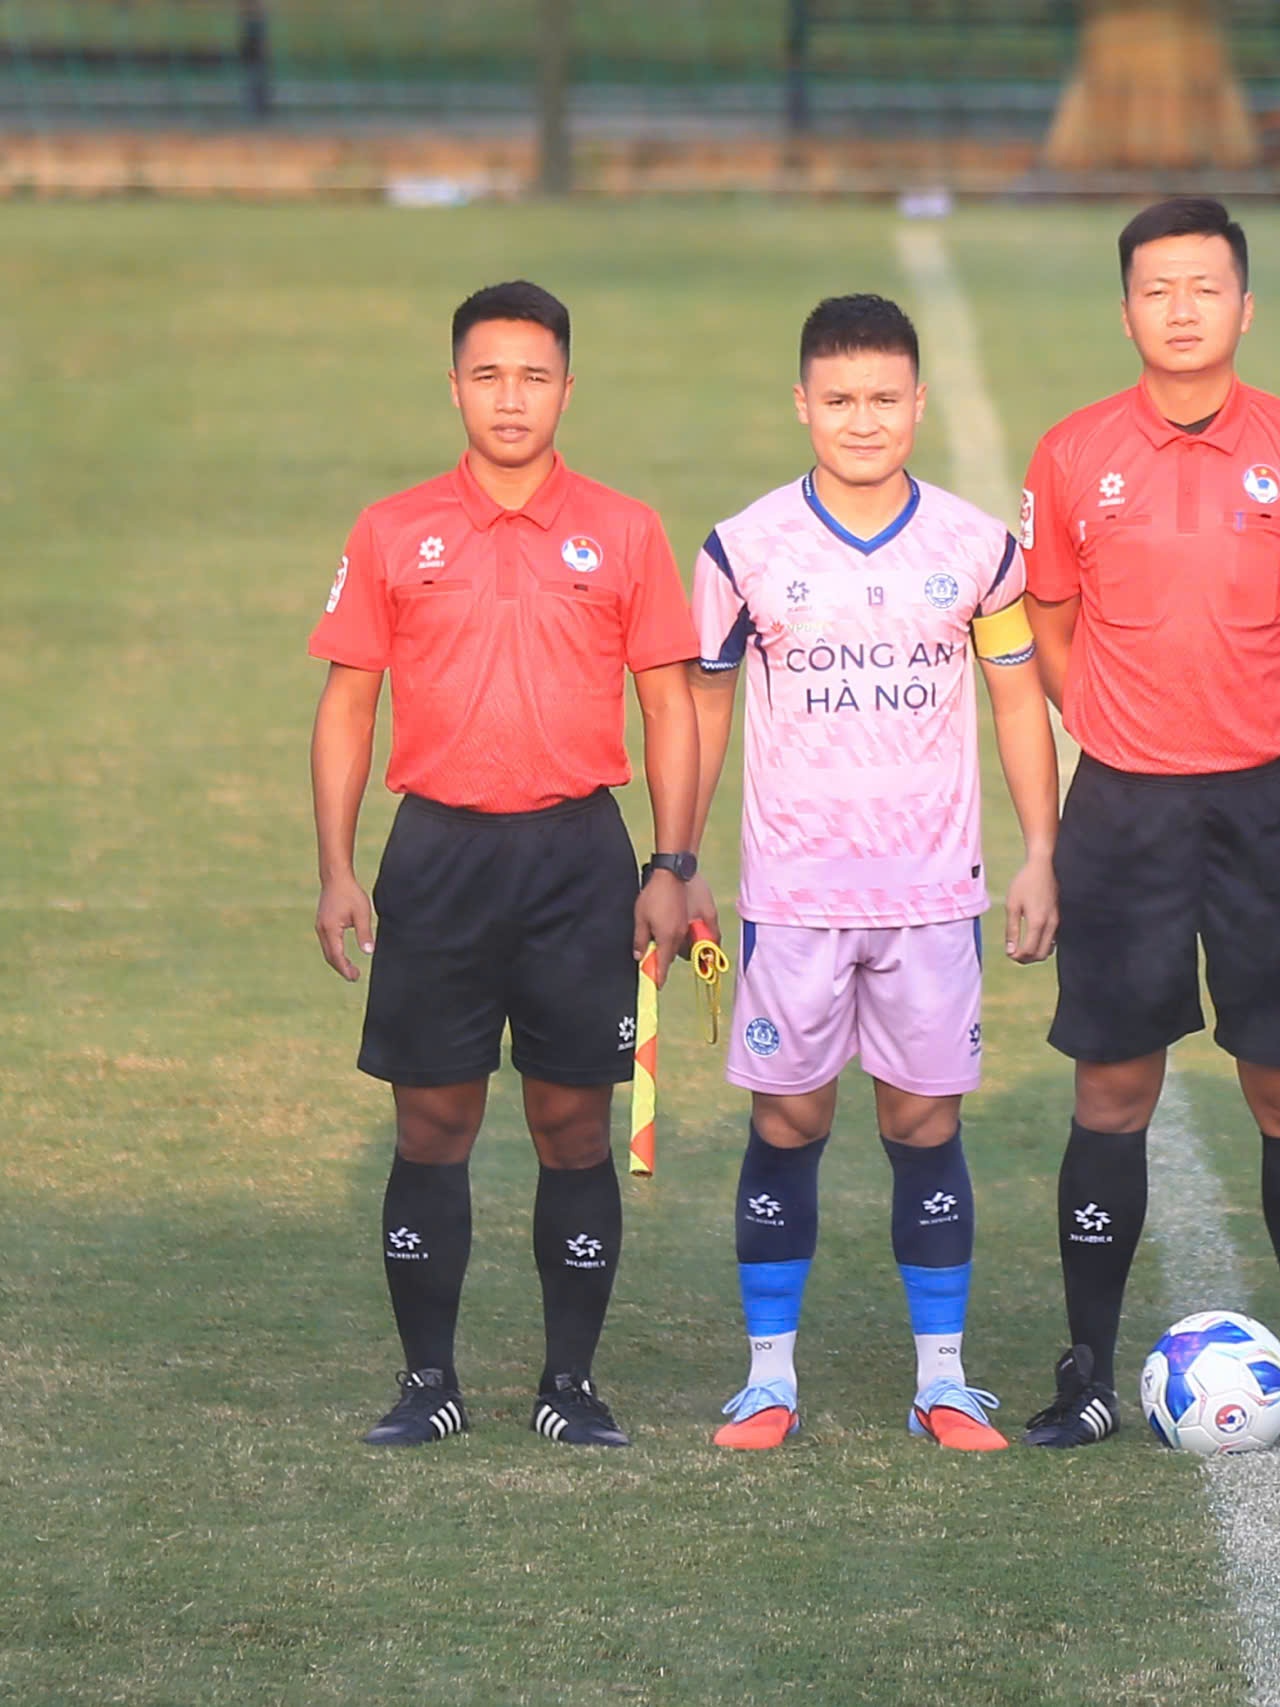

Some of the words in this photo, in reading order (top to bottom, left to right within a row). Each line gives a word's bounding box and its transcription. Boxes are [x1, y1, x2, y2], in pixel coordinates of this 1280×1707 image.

[866, 586, 884, 607] 19
[786, 638, 895, 673] CÔNG
[908, 642, 955, 669] AN
[806, 678, 861, 715] HÀ
[875, 676, 937, 717] NỘI
